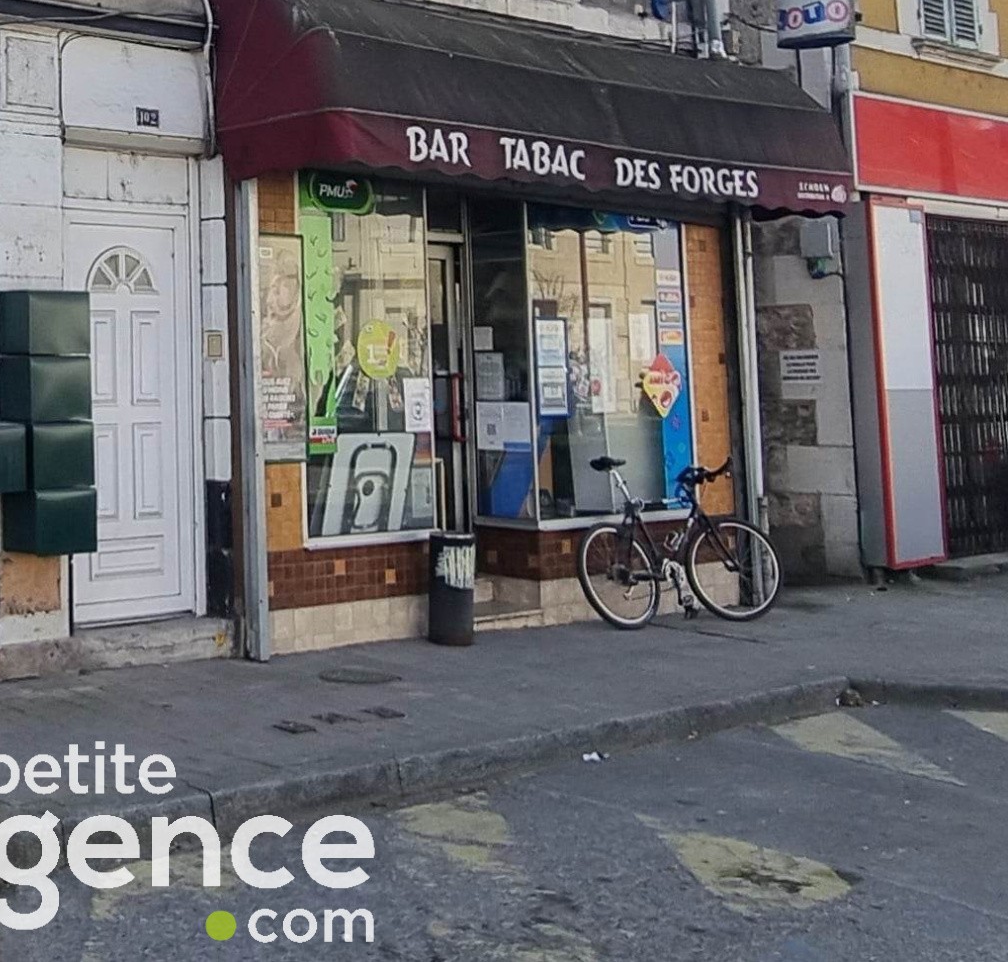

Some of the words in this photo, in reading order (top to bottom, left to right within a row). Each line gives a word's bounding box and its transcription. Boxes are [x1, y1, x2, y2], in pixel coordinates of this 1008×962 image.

[406, 125, 472, 168] BAR
[499, 137, 586, 181] TABAC
[614, 157, 661, 190] DES
[668, 164, 759, 198] FORGES
[319, 183, 345, 198] PMU
